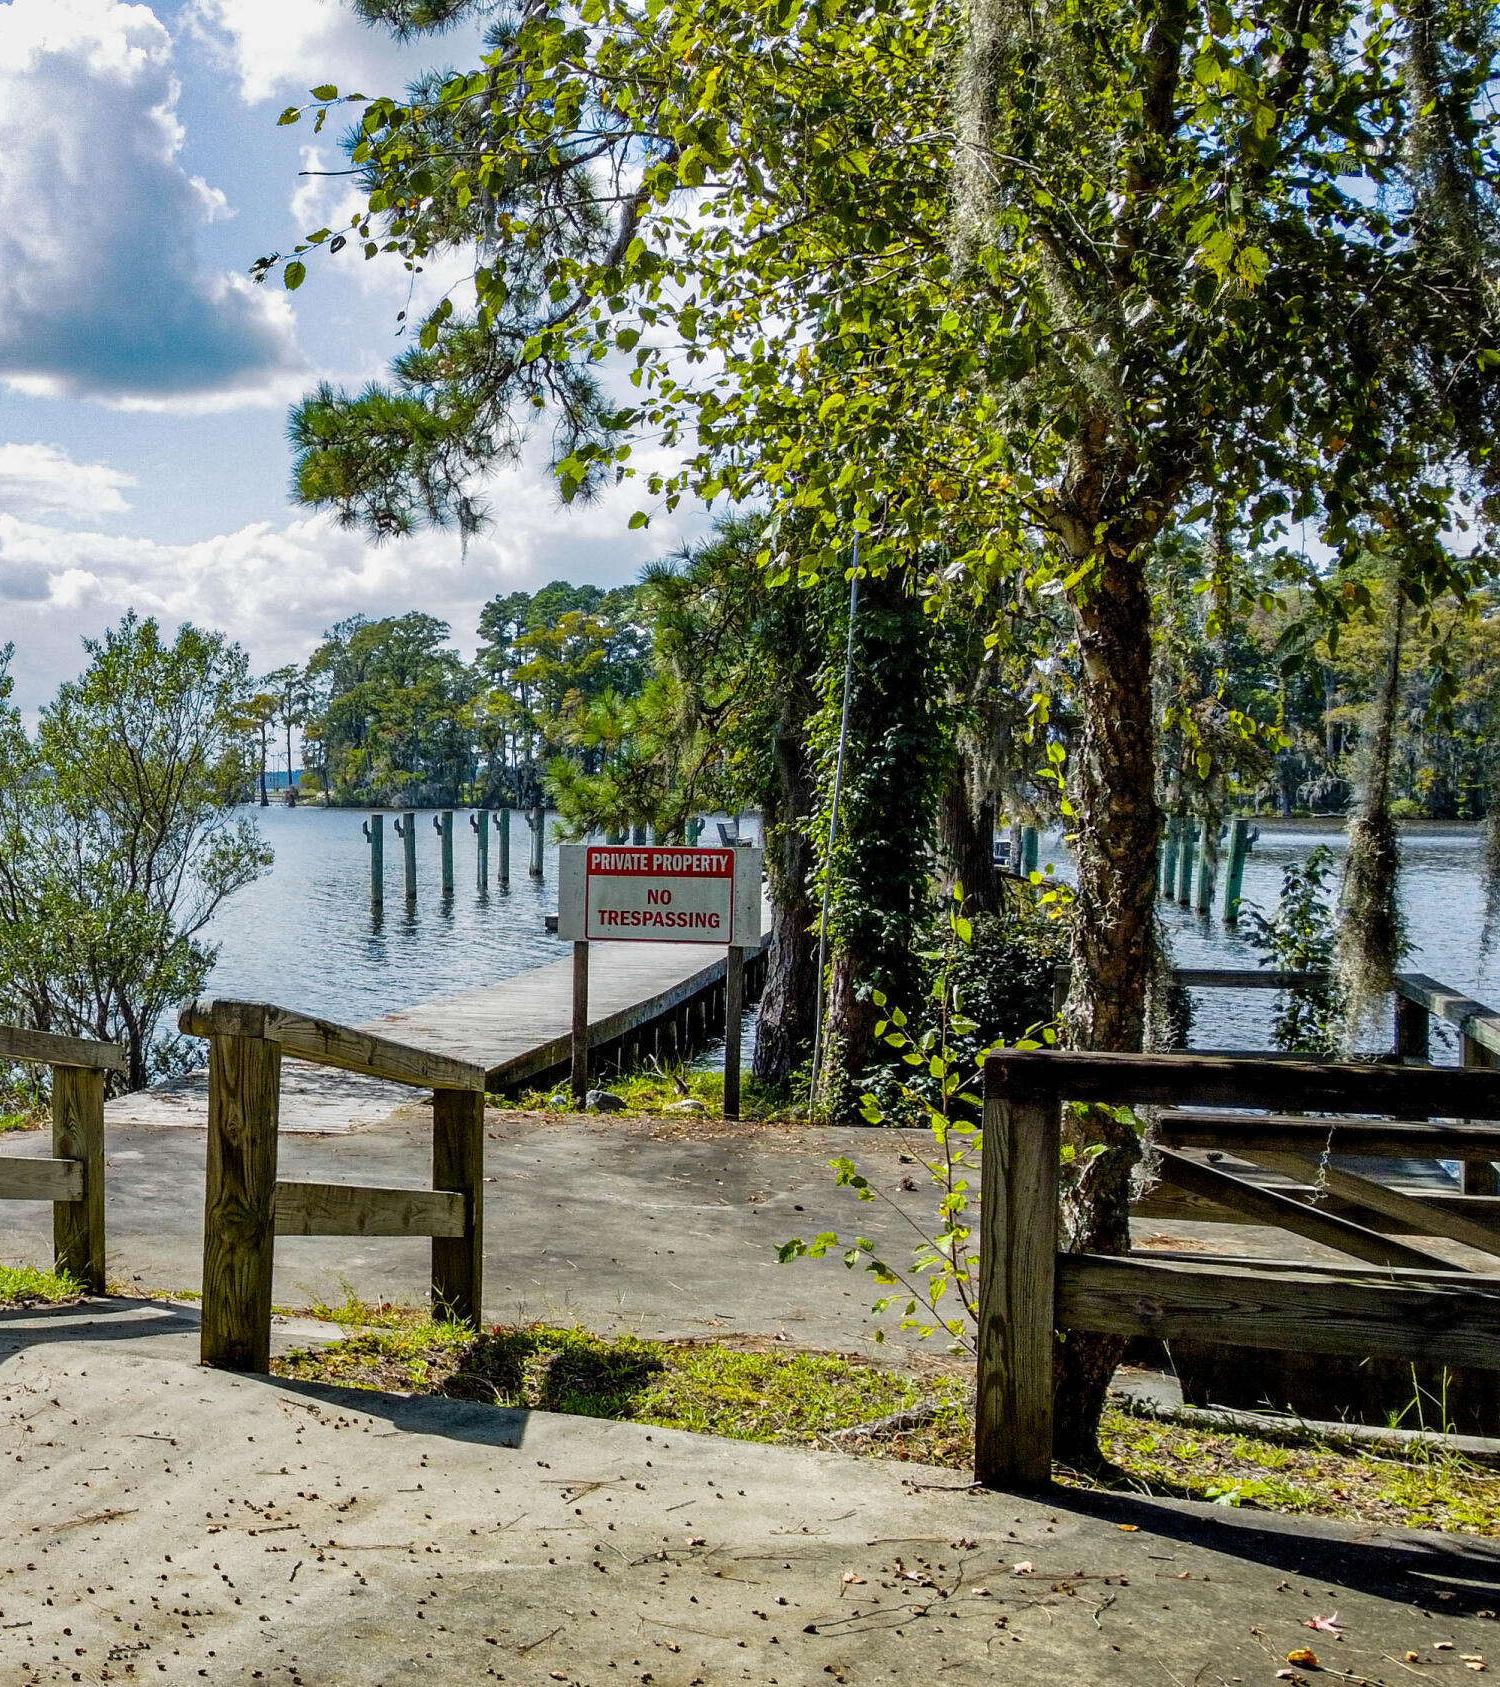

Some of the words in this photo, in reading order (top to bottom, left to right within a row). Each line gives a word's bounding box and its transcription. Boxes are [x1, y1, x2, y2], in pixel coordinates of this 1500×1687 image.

[591, 852, 649, 871] PRIVATE
[653, 853, 729, 872] PROPERTY
[647, 889, 672, 905] NO
[598, 910, 720, 929] TRESPASSING
